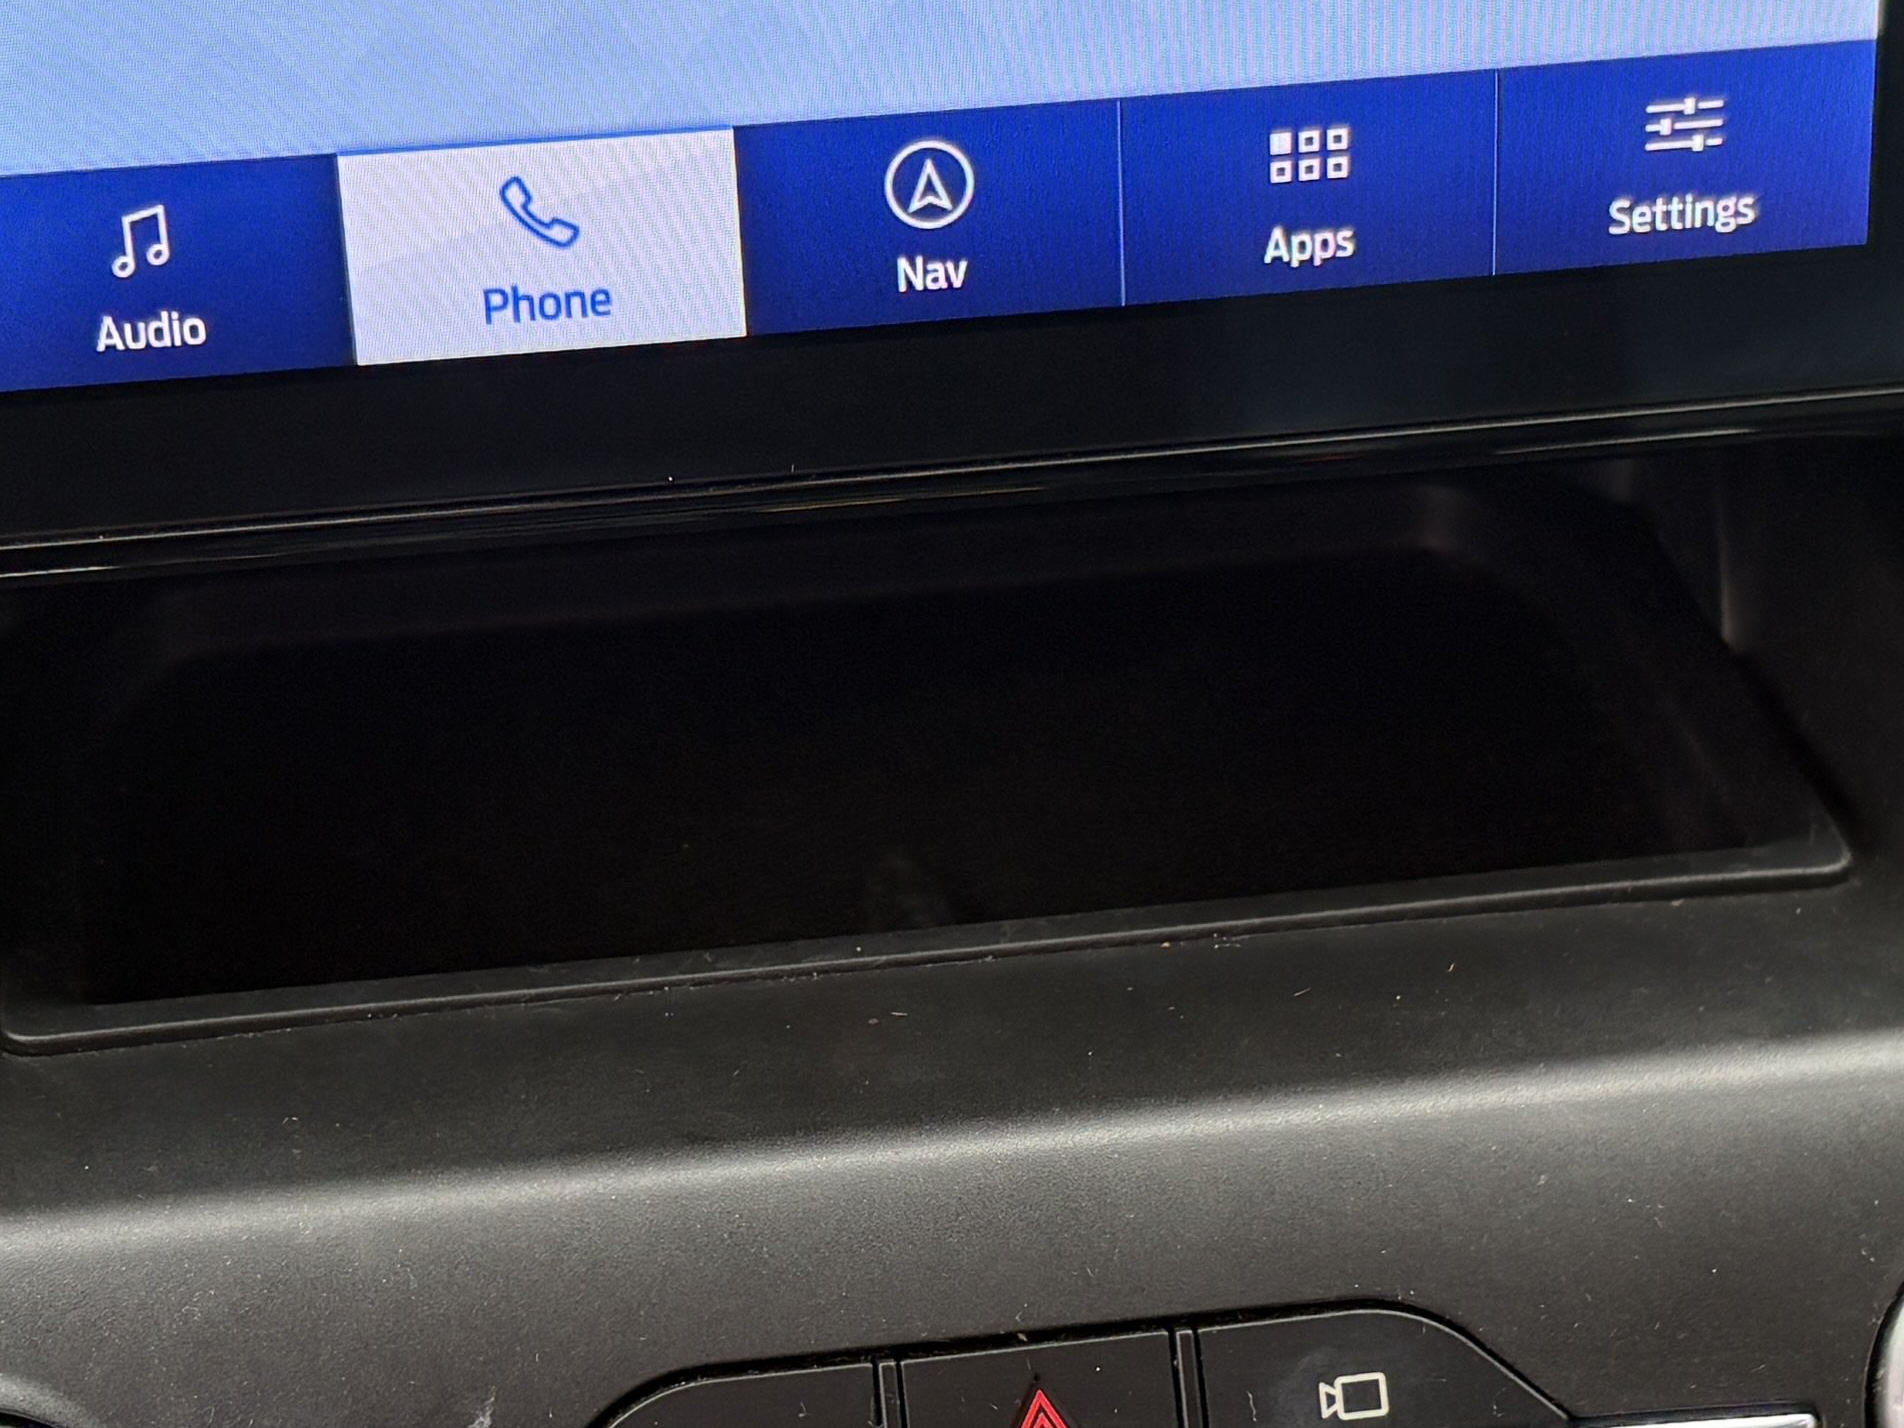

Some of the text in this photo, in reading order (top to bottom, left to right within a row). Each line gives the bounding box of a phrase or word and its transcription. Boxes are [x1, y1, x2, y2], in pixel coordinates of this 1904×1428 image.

[1608, 191, 1756, 237] Settings
[1263, 223, 1355, 270] Apps
[896, 253, 968, 293] Nav
[483, 282, 613, 327] Phone
[97, 308, 207, 354] Audio
